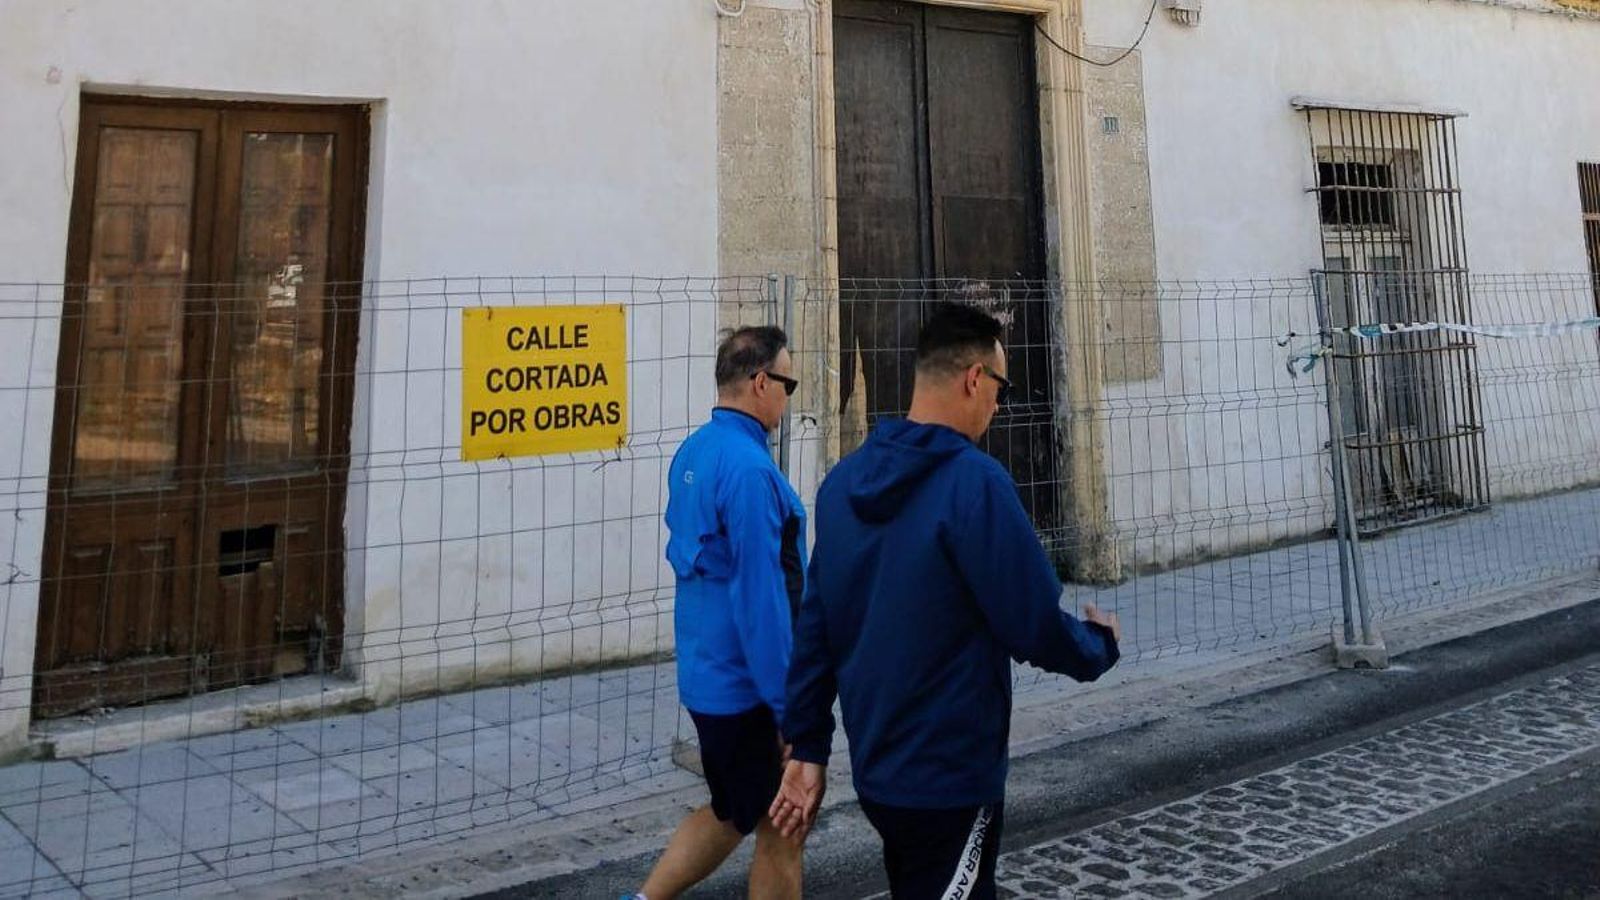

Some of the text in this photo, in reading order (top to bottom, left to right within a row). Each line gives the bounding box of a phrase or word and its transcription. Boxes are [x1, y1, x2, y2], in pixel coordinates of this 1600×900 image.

[507, 324, 589, 351] CALLE
[486, 363, 608, 393] CORTADA
[470, 401, 621, 436] POR OBRAS
[949, 873, 969, 900] AR
